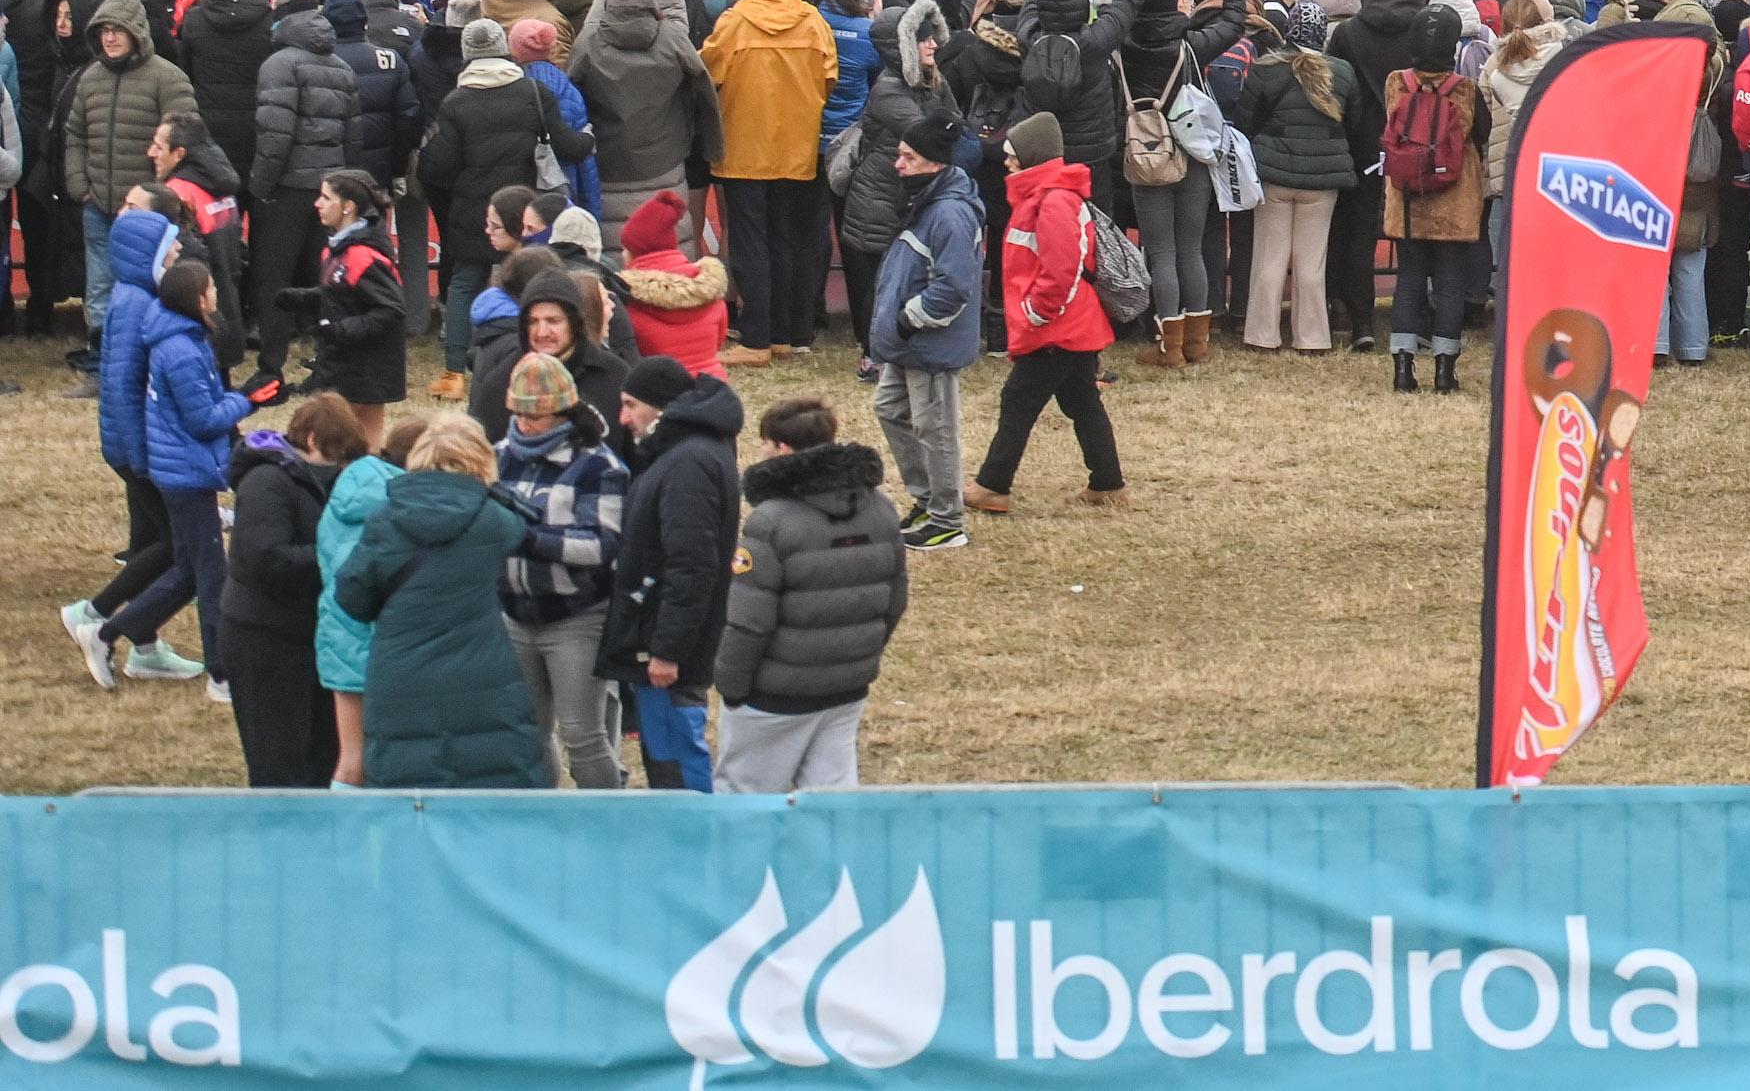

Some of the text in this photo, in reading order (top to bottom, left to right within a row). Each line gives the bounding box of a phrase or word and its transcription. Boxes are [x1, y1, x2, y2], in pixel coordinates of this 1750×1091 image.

[375, 49, 396, 70] 67
[0, 928, 242, 1066] ola
[992, 914, 1700, 1062] Iberdrola
